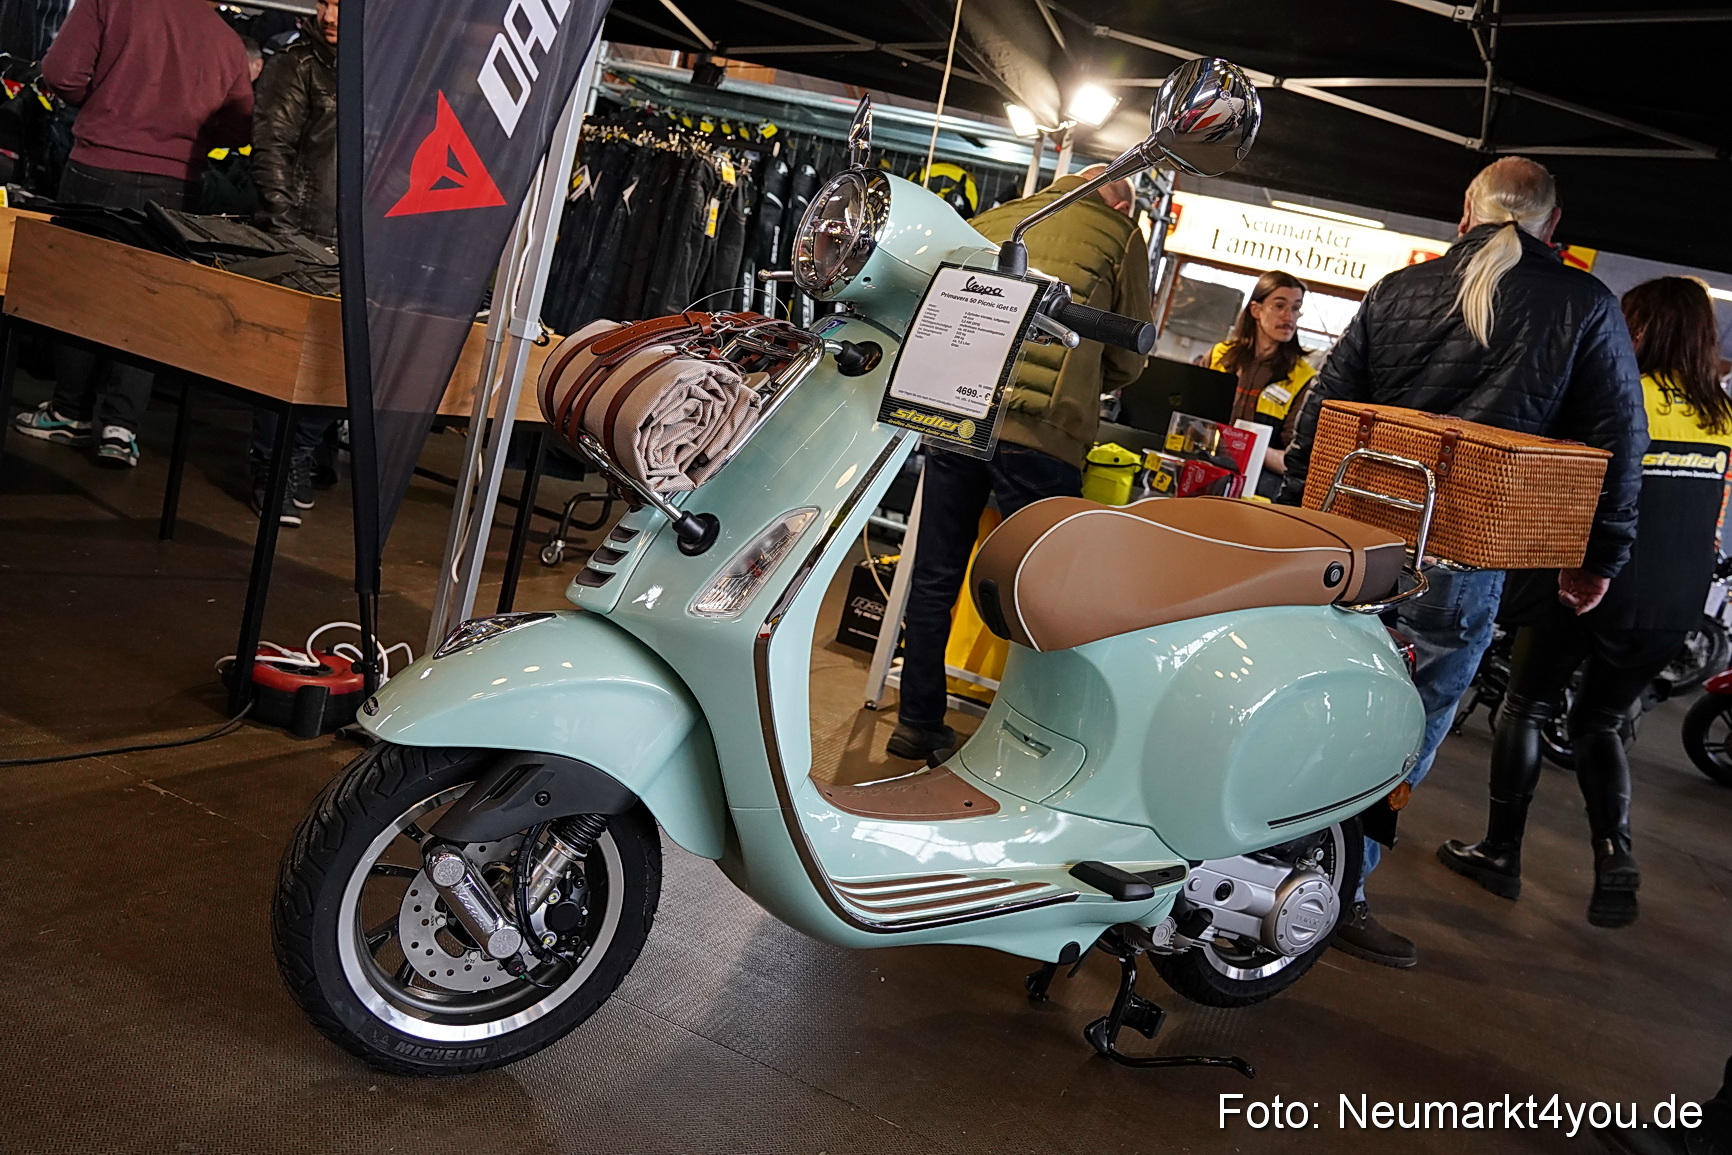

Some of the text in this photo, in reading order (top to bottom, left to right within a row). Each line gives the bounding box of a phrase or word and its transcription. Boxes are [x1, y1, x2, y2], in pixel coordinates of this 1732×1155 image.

[1242, 213, 1352, 249] Neumarkter
[1211, 228, 1367, 280] Lammsbräu
[960, 275, 1005, 297] Vespa
[940, 291, 968, 303] Primavera
[977, 299, 995, 308] Picnic
[996, 302, 1009, 311] iGet
[890, 408, 962, 432] stadler
[1641, 451, 1717, 470] stadler
[394, 1040, 487, 1060] MICHELIN
